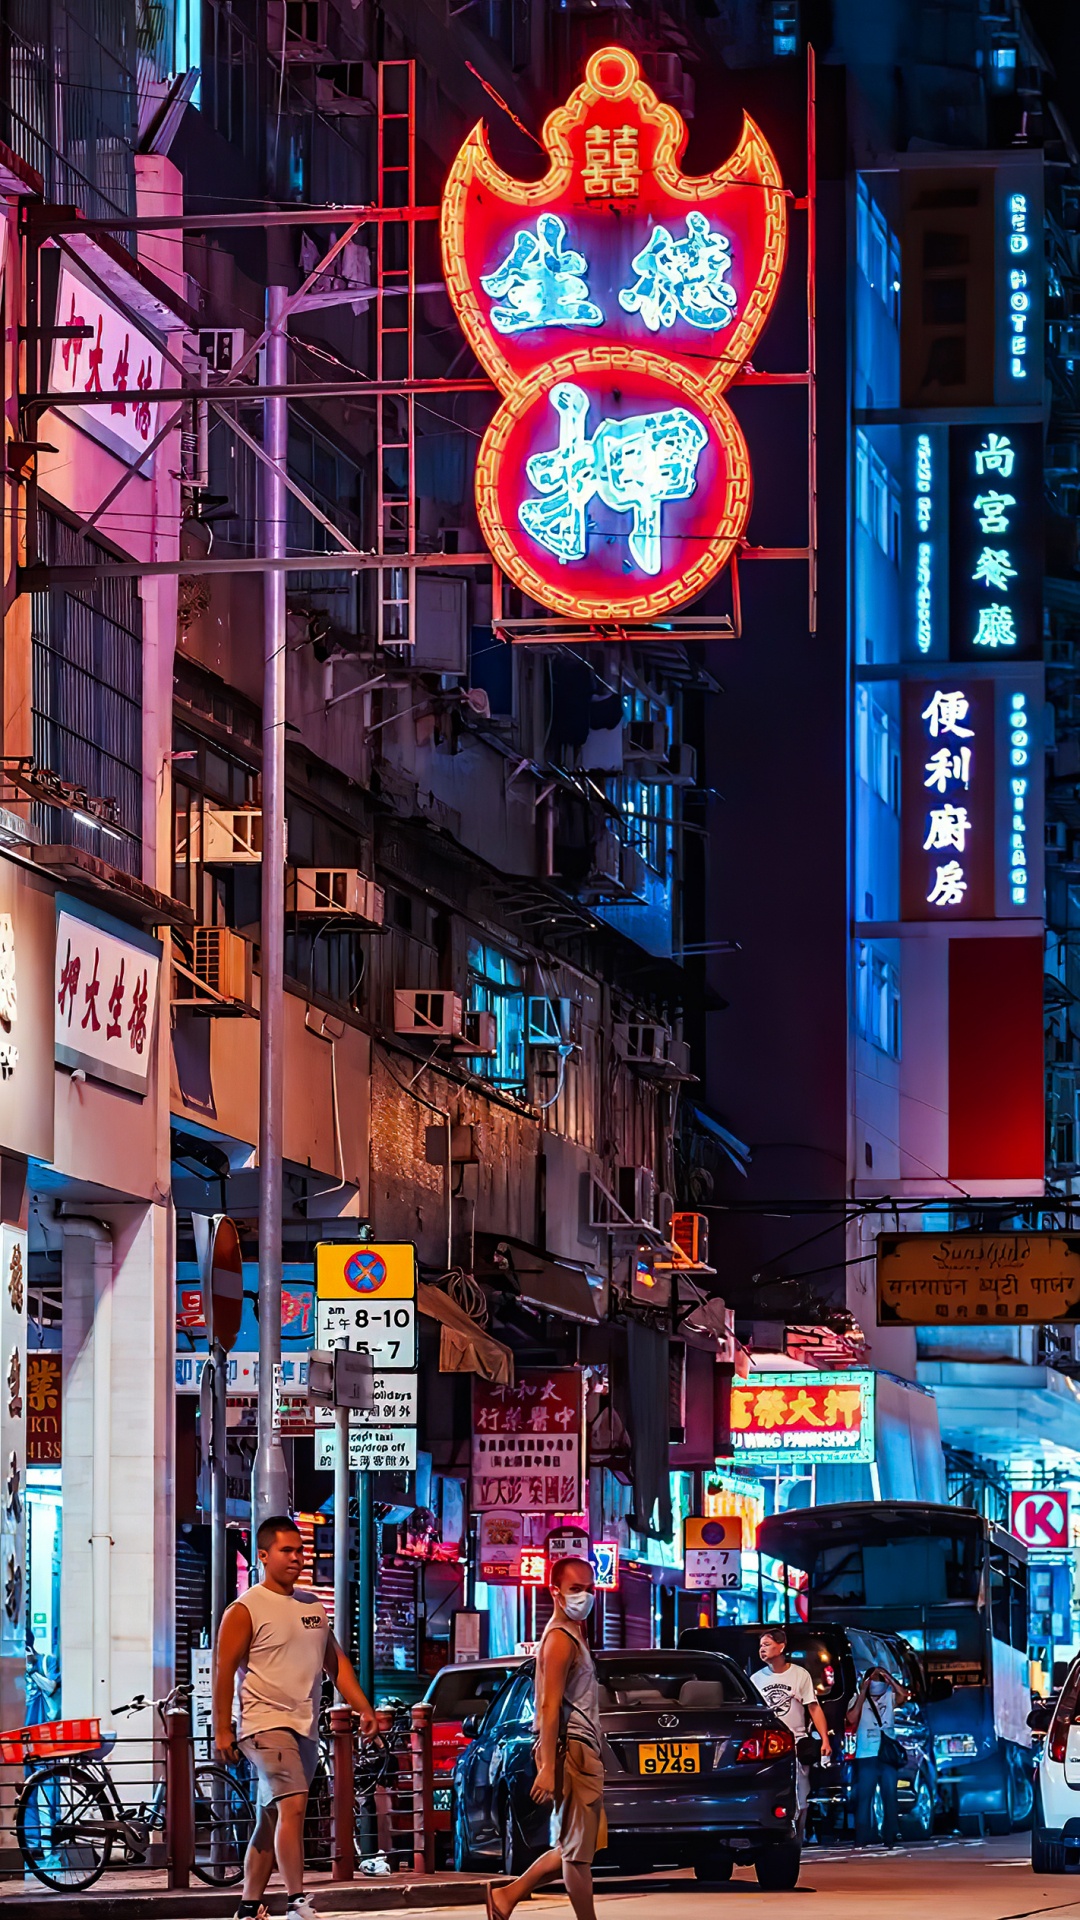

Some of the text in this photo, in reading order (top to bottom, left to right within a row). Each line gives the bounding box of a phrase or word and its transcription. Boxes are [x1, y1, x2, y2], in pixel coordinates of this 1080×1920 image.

[1010, 269, 1030, 378] HOTEL
[518, 381, 710, 577] 押
[1010, 693, 1028, 905] FOOD VILLAGE
[328, 1306, 345, 1315] am
[355, 1309, 409, 1328] 8-10
[323, 1318, 350, 1330] 上午
[372, 1390, 412, 1402] olidays
[783, 1431, 860, 1449] PAWNSHOP
[1025, 1500, 1059, 1542] K
[720, 1551, 730, 1565] 7
[721, 1573, 738, 1587] 12
[656, 1743, 683, 1761] NU
[644, 1758, 696, 1774] 9749
